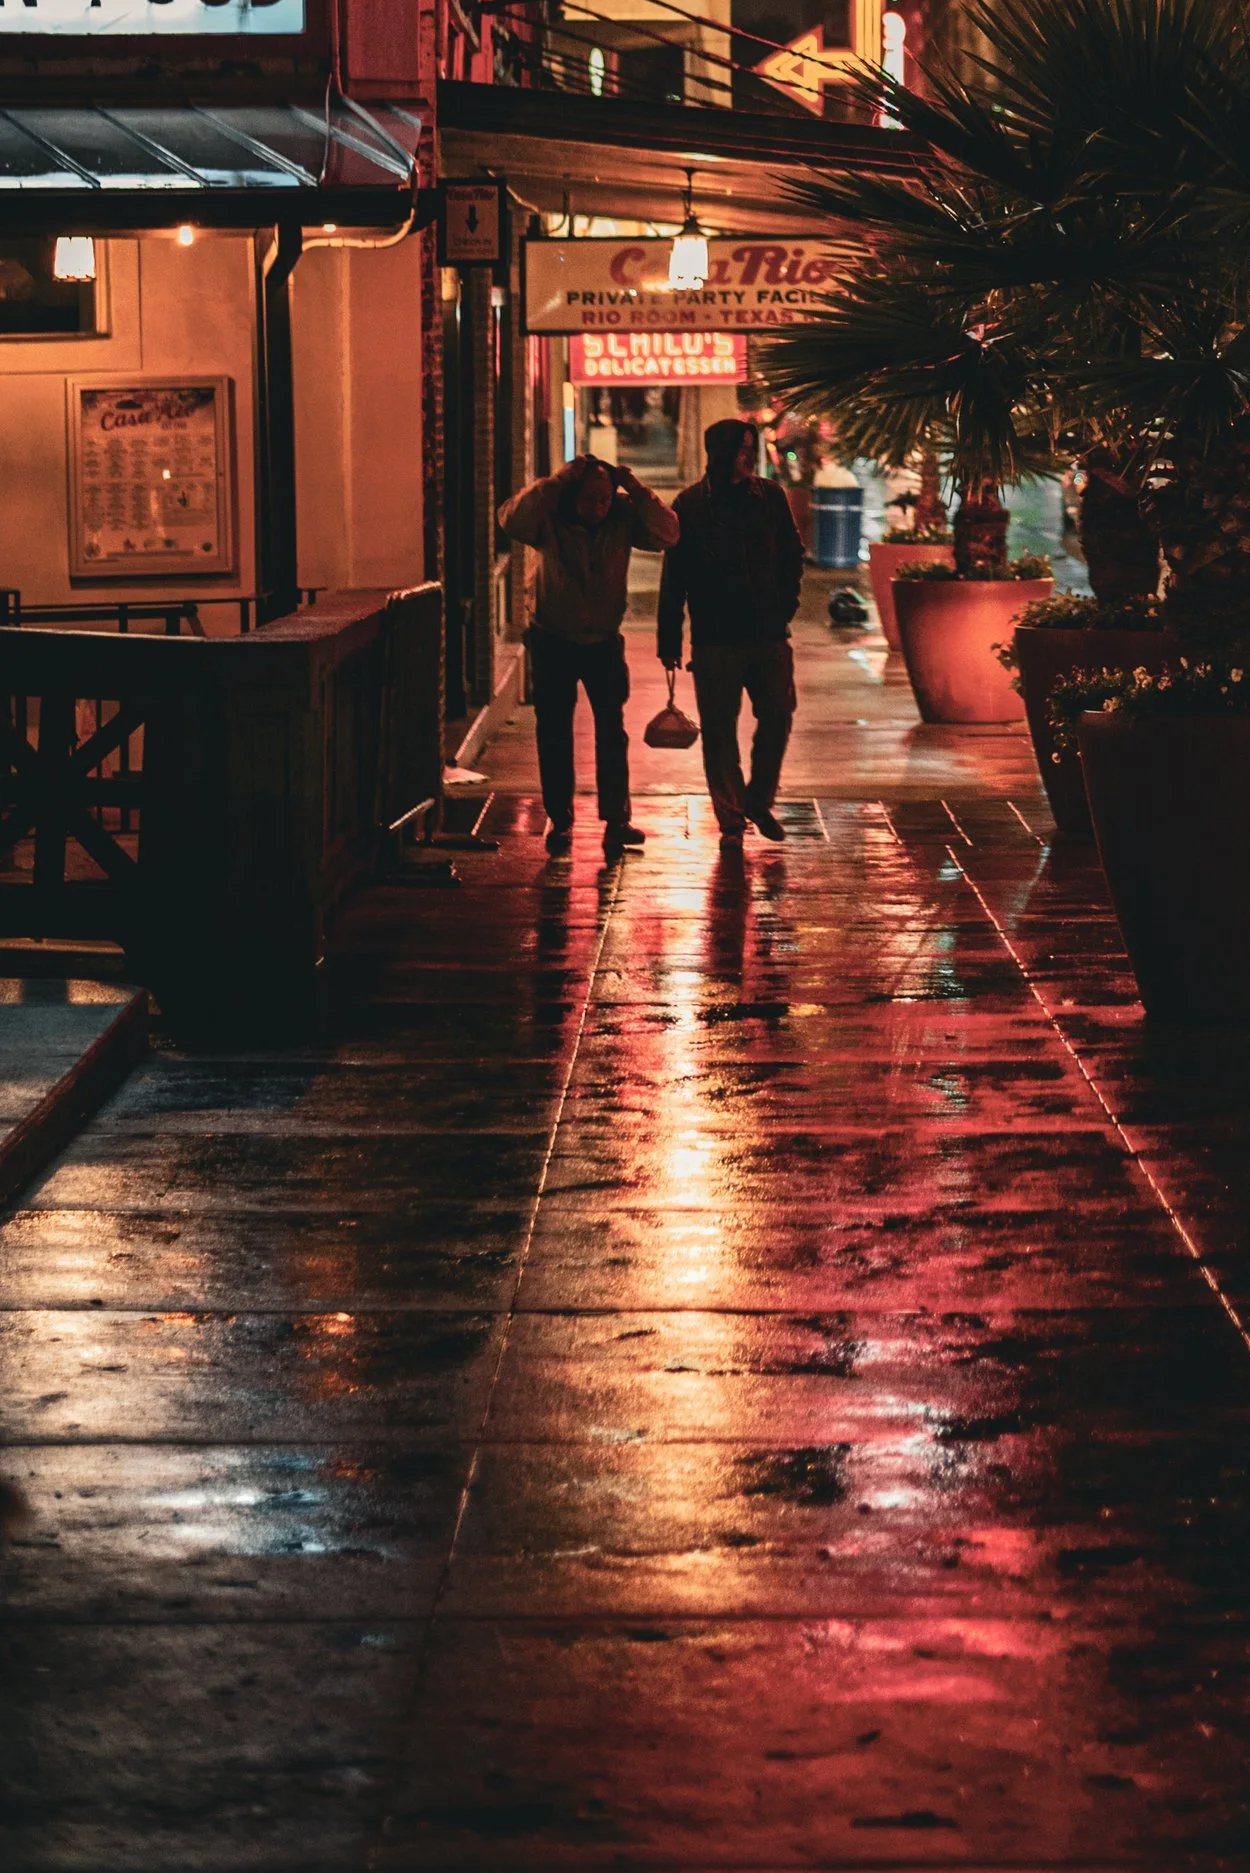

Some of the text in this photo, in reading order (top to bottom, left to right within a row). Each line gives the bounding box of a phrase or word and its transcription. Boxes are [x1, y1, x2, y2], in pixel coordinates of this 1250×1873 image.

[731, 245, 834, 286] Rio
[673, 290, 746, 306] PARTY
[581, 309, 621, 326] RIO
[628, 309, 697, 326] ROOM
[718, 308, 794, 326] TEXAS
[584, 356, 737, 377] DELICATESSEN
[101, 410, 151, 431] Casa
